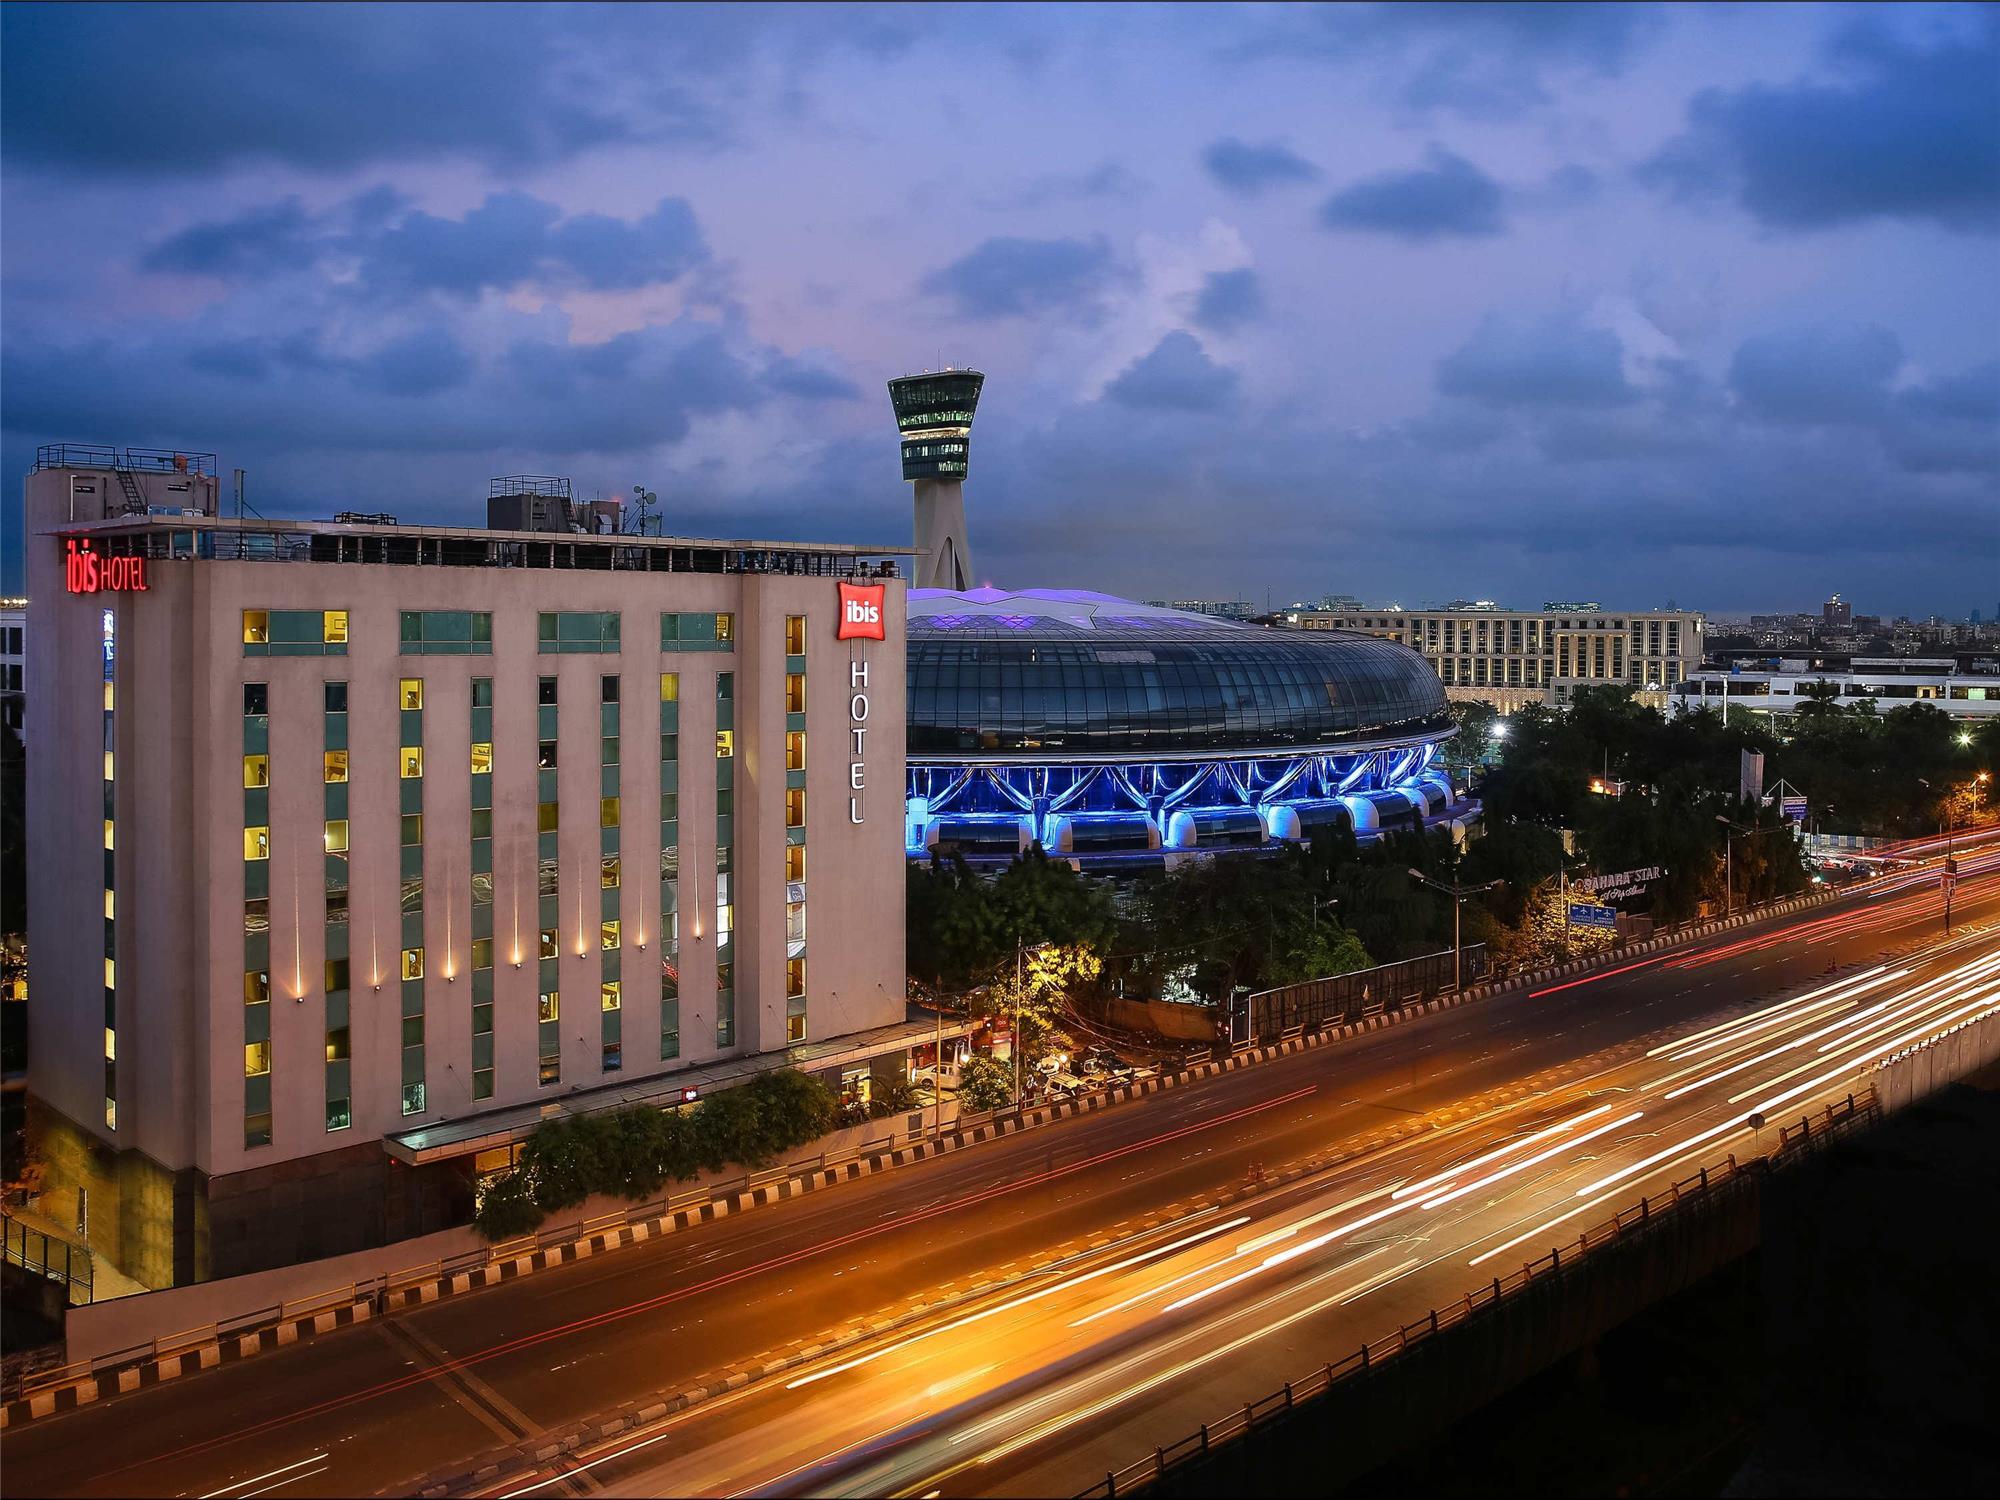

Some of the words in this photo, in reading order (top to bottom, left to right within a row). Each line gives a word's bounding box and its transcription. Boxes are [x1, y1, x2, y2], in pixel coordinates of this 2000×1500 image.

[67, 538, 98, 593] ibis
[101, 556, 147, 591] HOTEL
[846, 600, 879, 623] ibis
[850, 660, 869, 824] HOTEL
[1584, 872, 1631, 890] SAHARA
[1634, 866, 1661, 882] STAR
